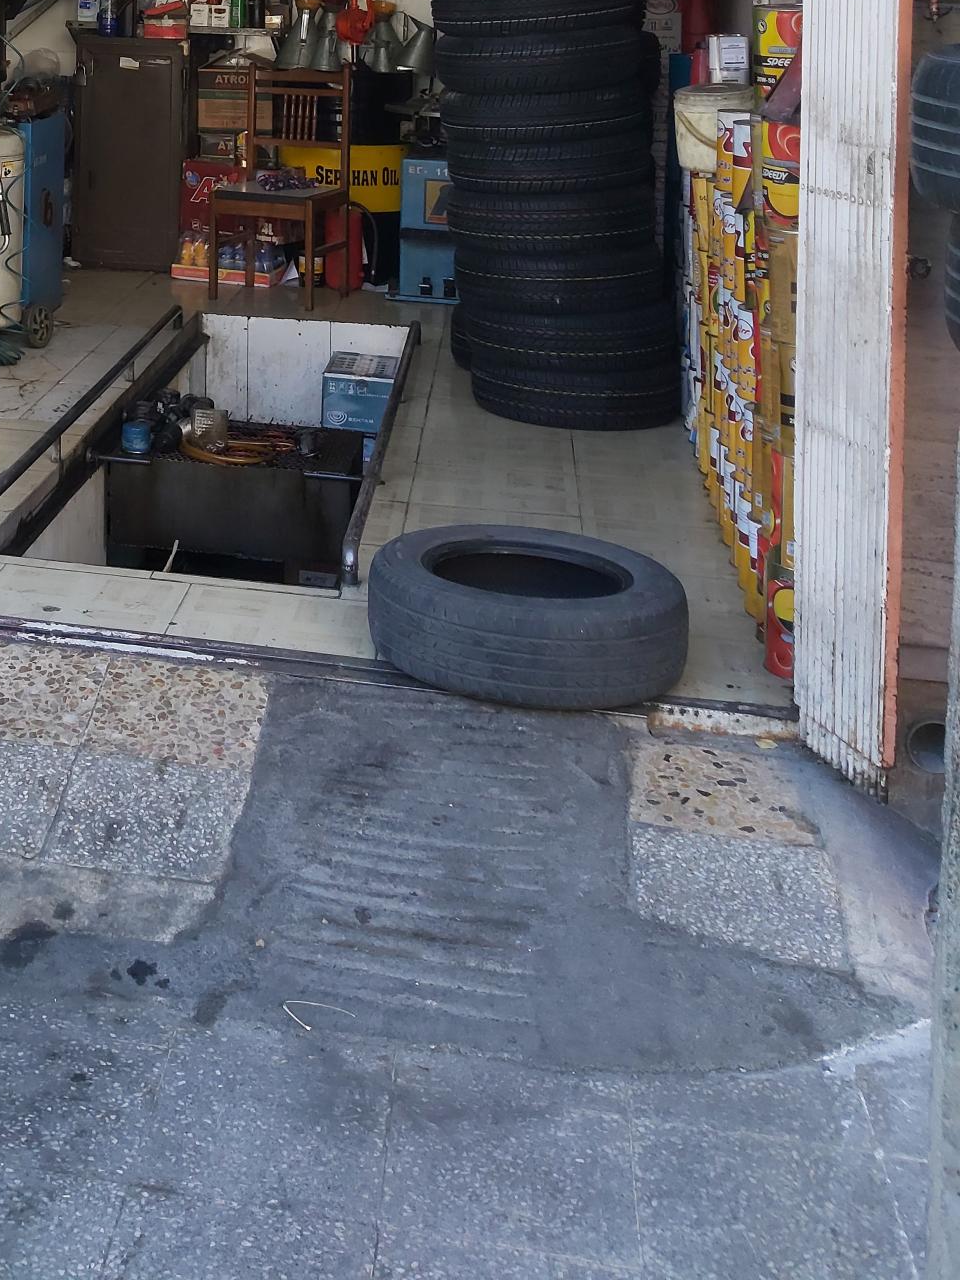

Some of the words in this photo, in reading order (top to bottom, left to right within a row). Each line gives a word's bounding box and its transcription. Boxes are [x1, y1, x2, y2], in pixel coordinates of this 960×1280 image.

[762, 57, 792, 67] SPEE
[215, 75, 248, 84] ATRO
[315, 165, 377, 186] SEPHAN
